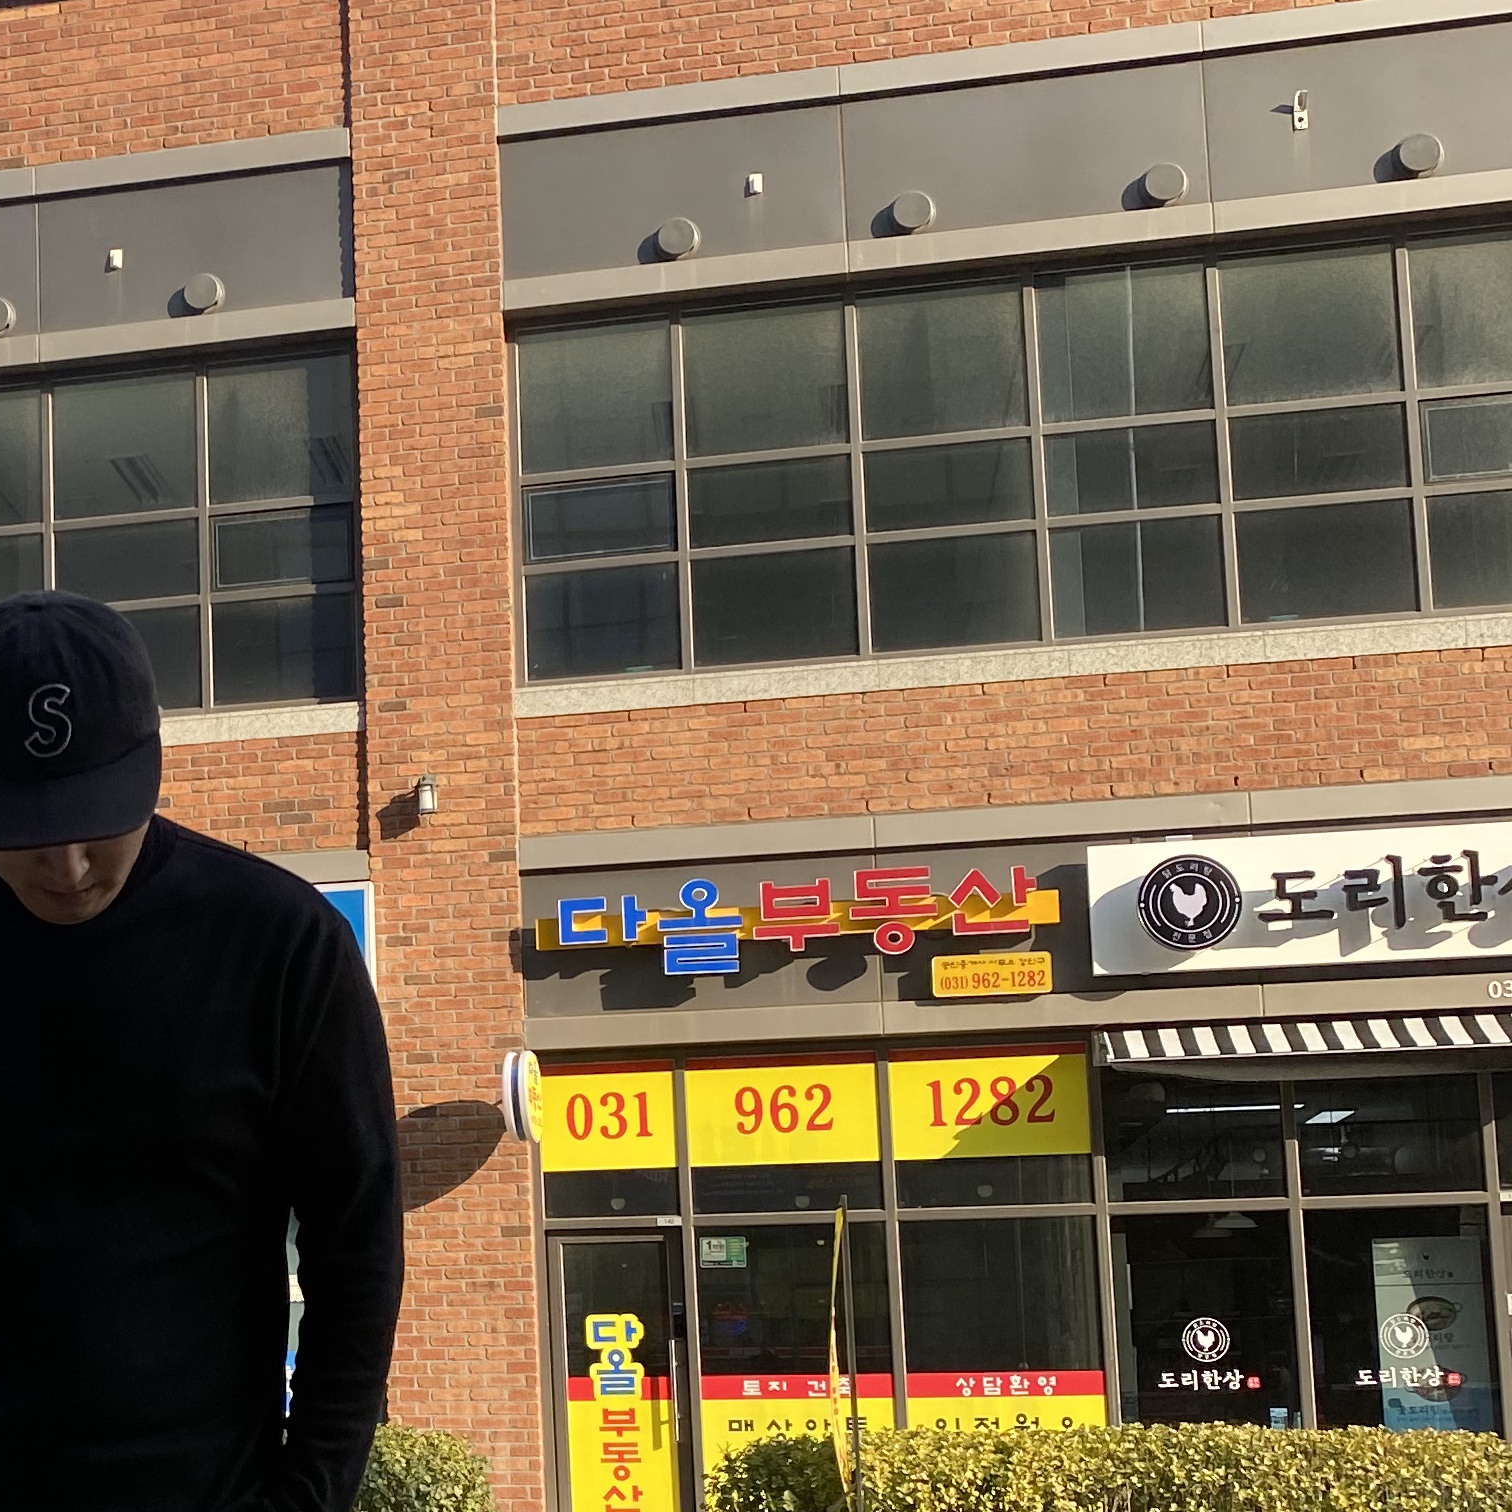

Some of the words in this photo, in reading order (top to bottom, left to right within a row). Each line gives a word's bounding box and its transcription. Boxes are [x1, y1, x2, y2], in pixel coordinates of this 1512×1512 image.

[23, 682, 73, 758] S
[1258, 849, 1512, 929] 도리한
[940, 975, 968, 990] (031)
[972, 970, 1046, 989] 962-1282
[566, 1091, 653, 1141] 031
[734, 1083, 834, 1135] 962
[926, 1074, 1056, 1128] 1282
[742, 1378, 788, 1397] 토지
[1157, 1368, 1245, 1391] 도리한상
[1354, 1365, 1445, 1388] 도리한상
